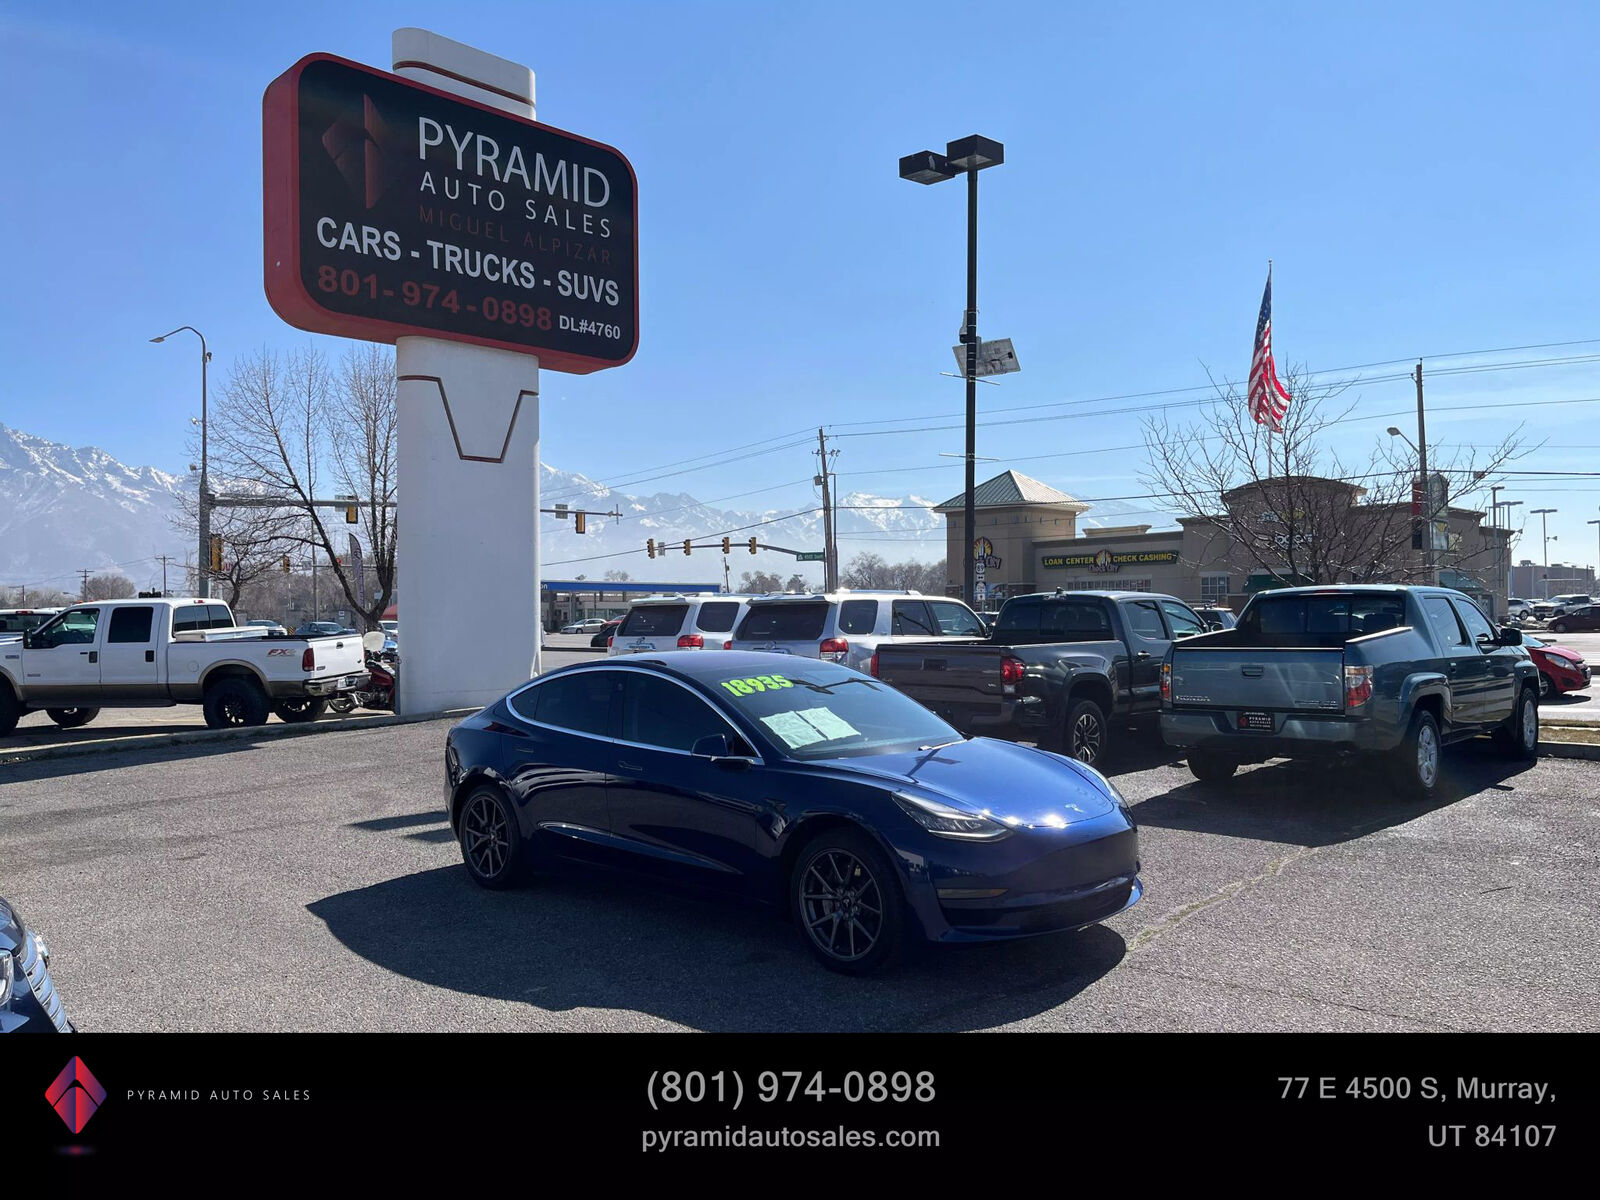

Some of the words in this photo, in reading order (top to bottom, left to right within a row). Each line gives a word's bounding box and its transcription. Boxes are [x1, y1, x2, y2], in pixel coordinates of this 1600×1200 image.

[418, 115, 611, 209] PYRAMID
[418, 204, 510, 242] MIGUEL
[524, 231, 612, 265] ALPIZAR
[420, 171, 506, 212] AUTO
[525, 199, 611, 238] SALES
[316, 216, 402, 261] CARS
[426, 239, 536, 289] TRUCKS
[557, 269, 619, 306] SUVS
[558, 314, 621, 340] DL#4760
[1044, 558, 1063, 566] LOAN
[1066, 556, 1094, 565] CENTER
[1112, 554, 1137, 563] CHECK
[1138, 553, 1172, 562] CASHING
[721, 675, 794, 697] 18935
